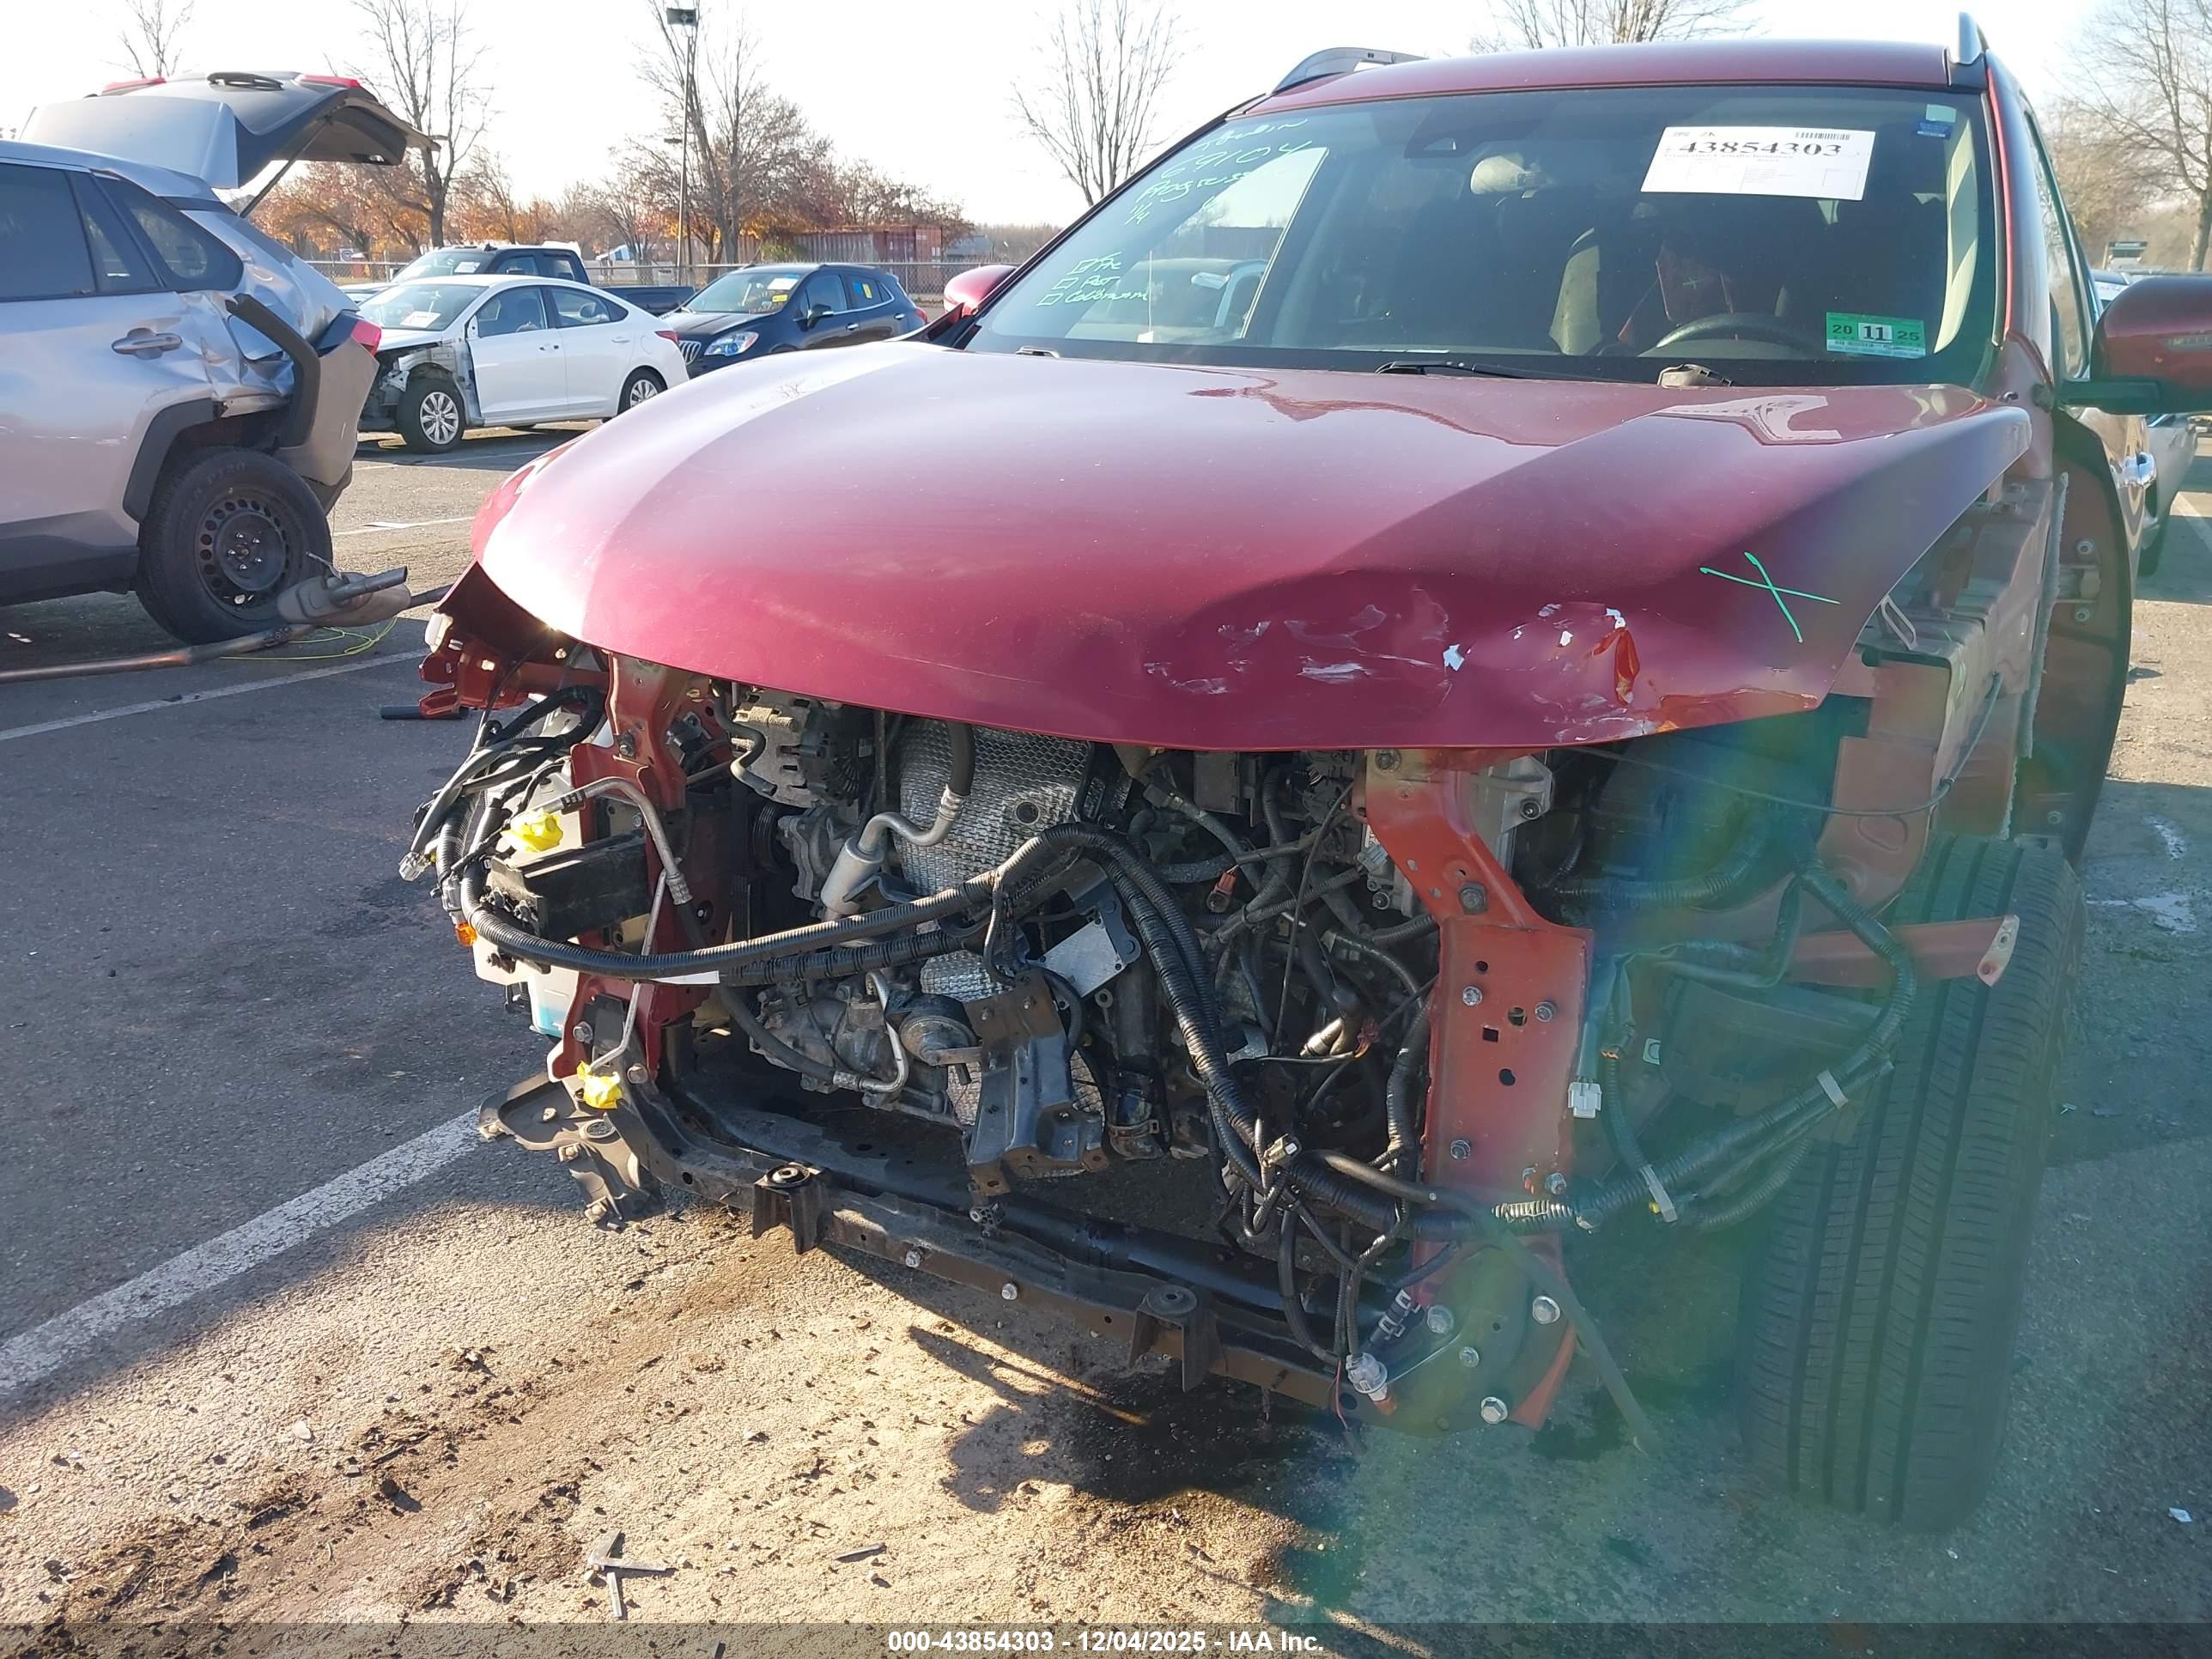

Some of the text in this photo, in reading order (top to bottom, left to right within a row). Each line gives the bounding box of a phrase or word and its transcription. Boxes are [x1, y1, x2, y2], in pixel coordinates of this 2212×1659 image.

[1678, 141, 1842, 157] 43854303
[1832, 325, 1920, 342] 20 11 25
